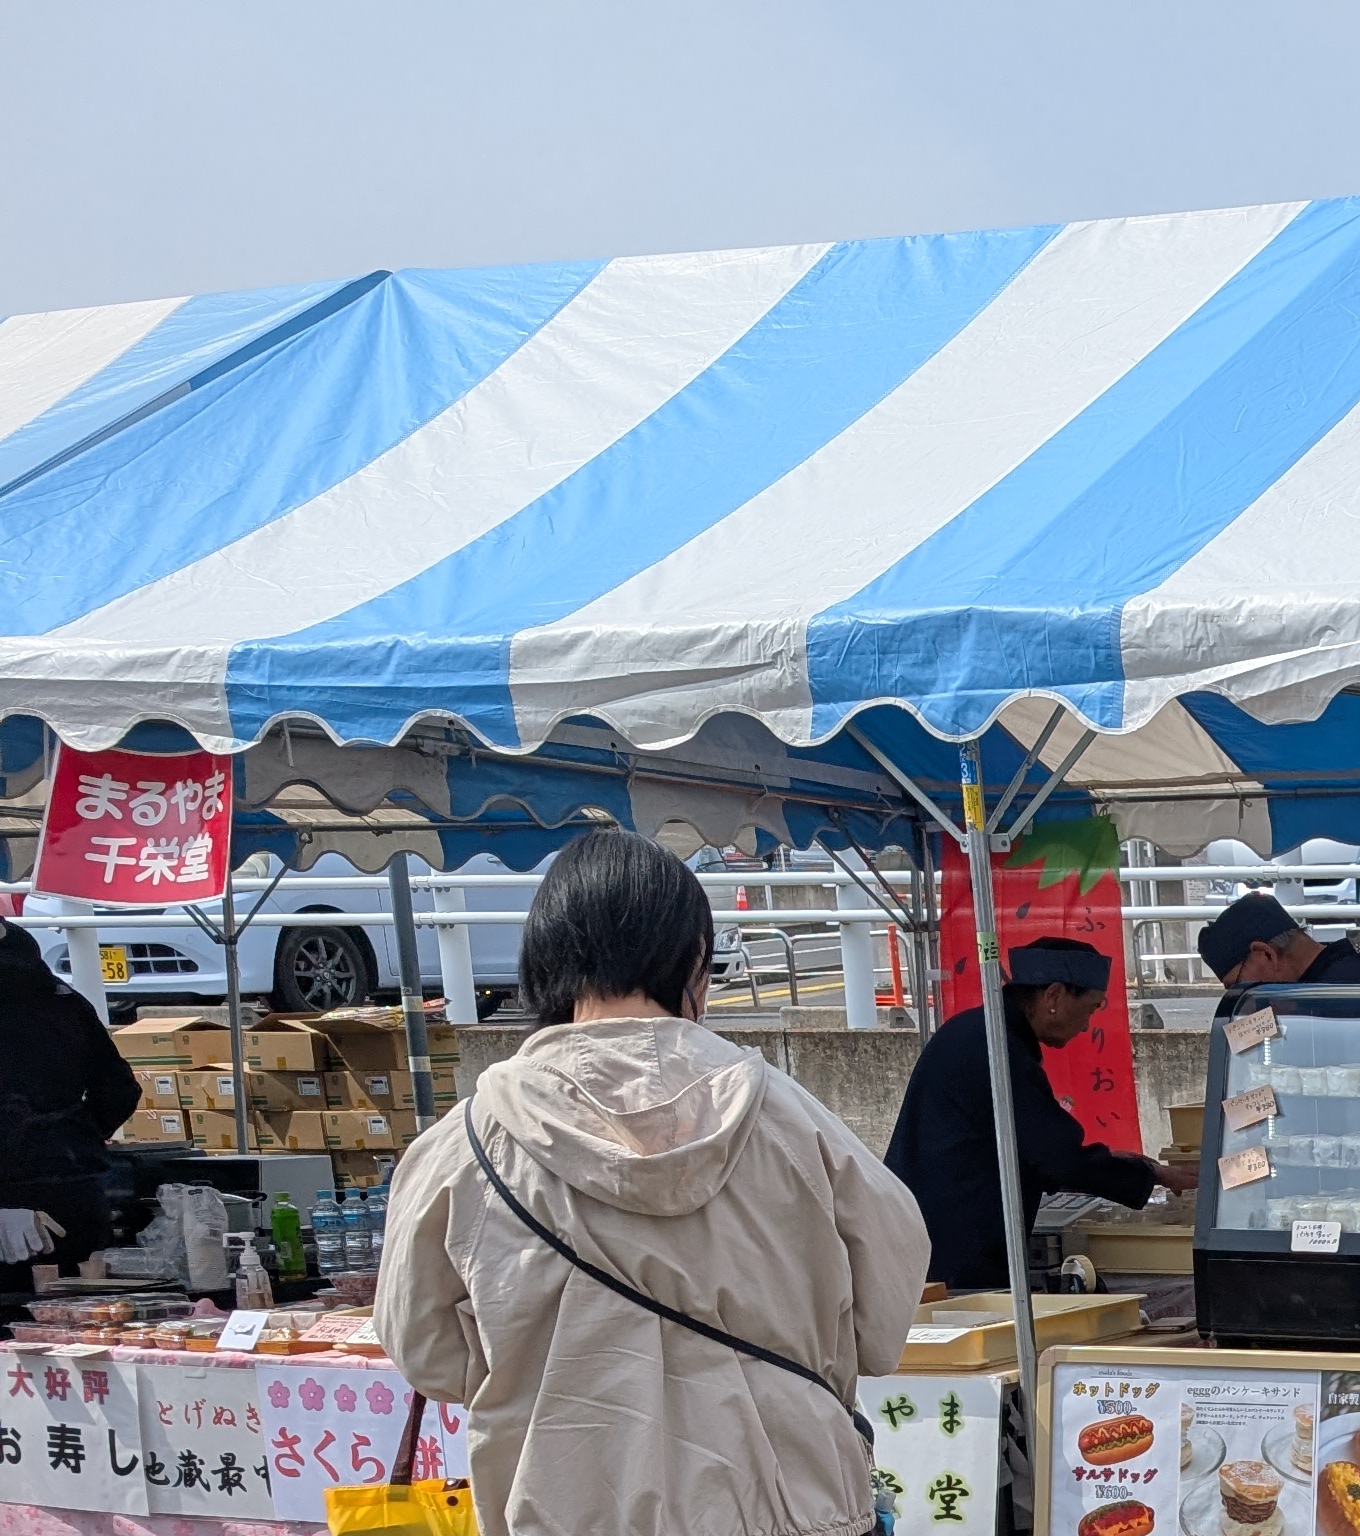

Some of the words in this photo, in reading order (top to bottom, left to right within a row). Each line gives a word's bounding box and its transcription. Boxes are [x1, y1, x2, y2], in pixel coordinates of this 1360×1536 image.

[75, 769, 226, 827] まるやま
[84, 831, 214, 886] 千栄堂
[7, 1363, 111, 1406] 大好評
[1073, 1381, 1161, 1399] ホットドッグ
[156, 1398, 262, 1434] とげぬき
[0, 1422, 140, 1476] お寿し
[1071, 1465, 1159, 1485] サルサドッグ
